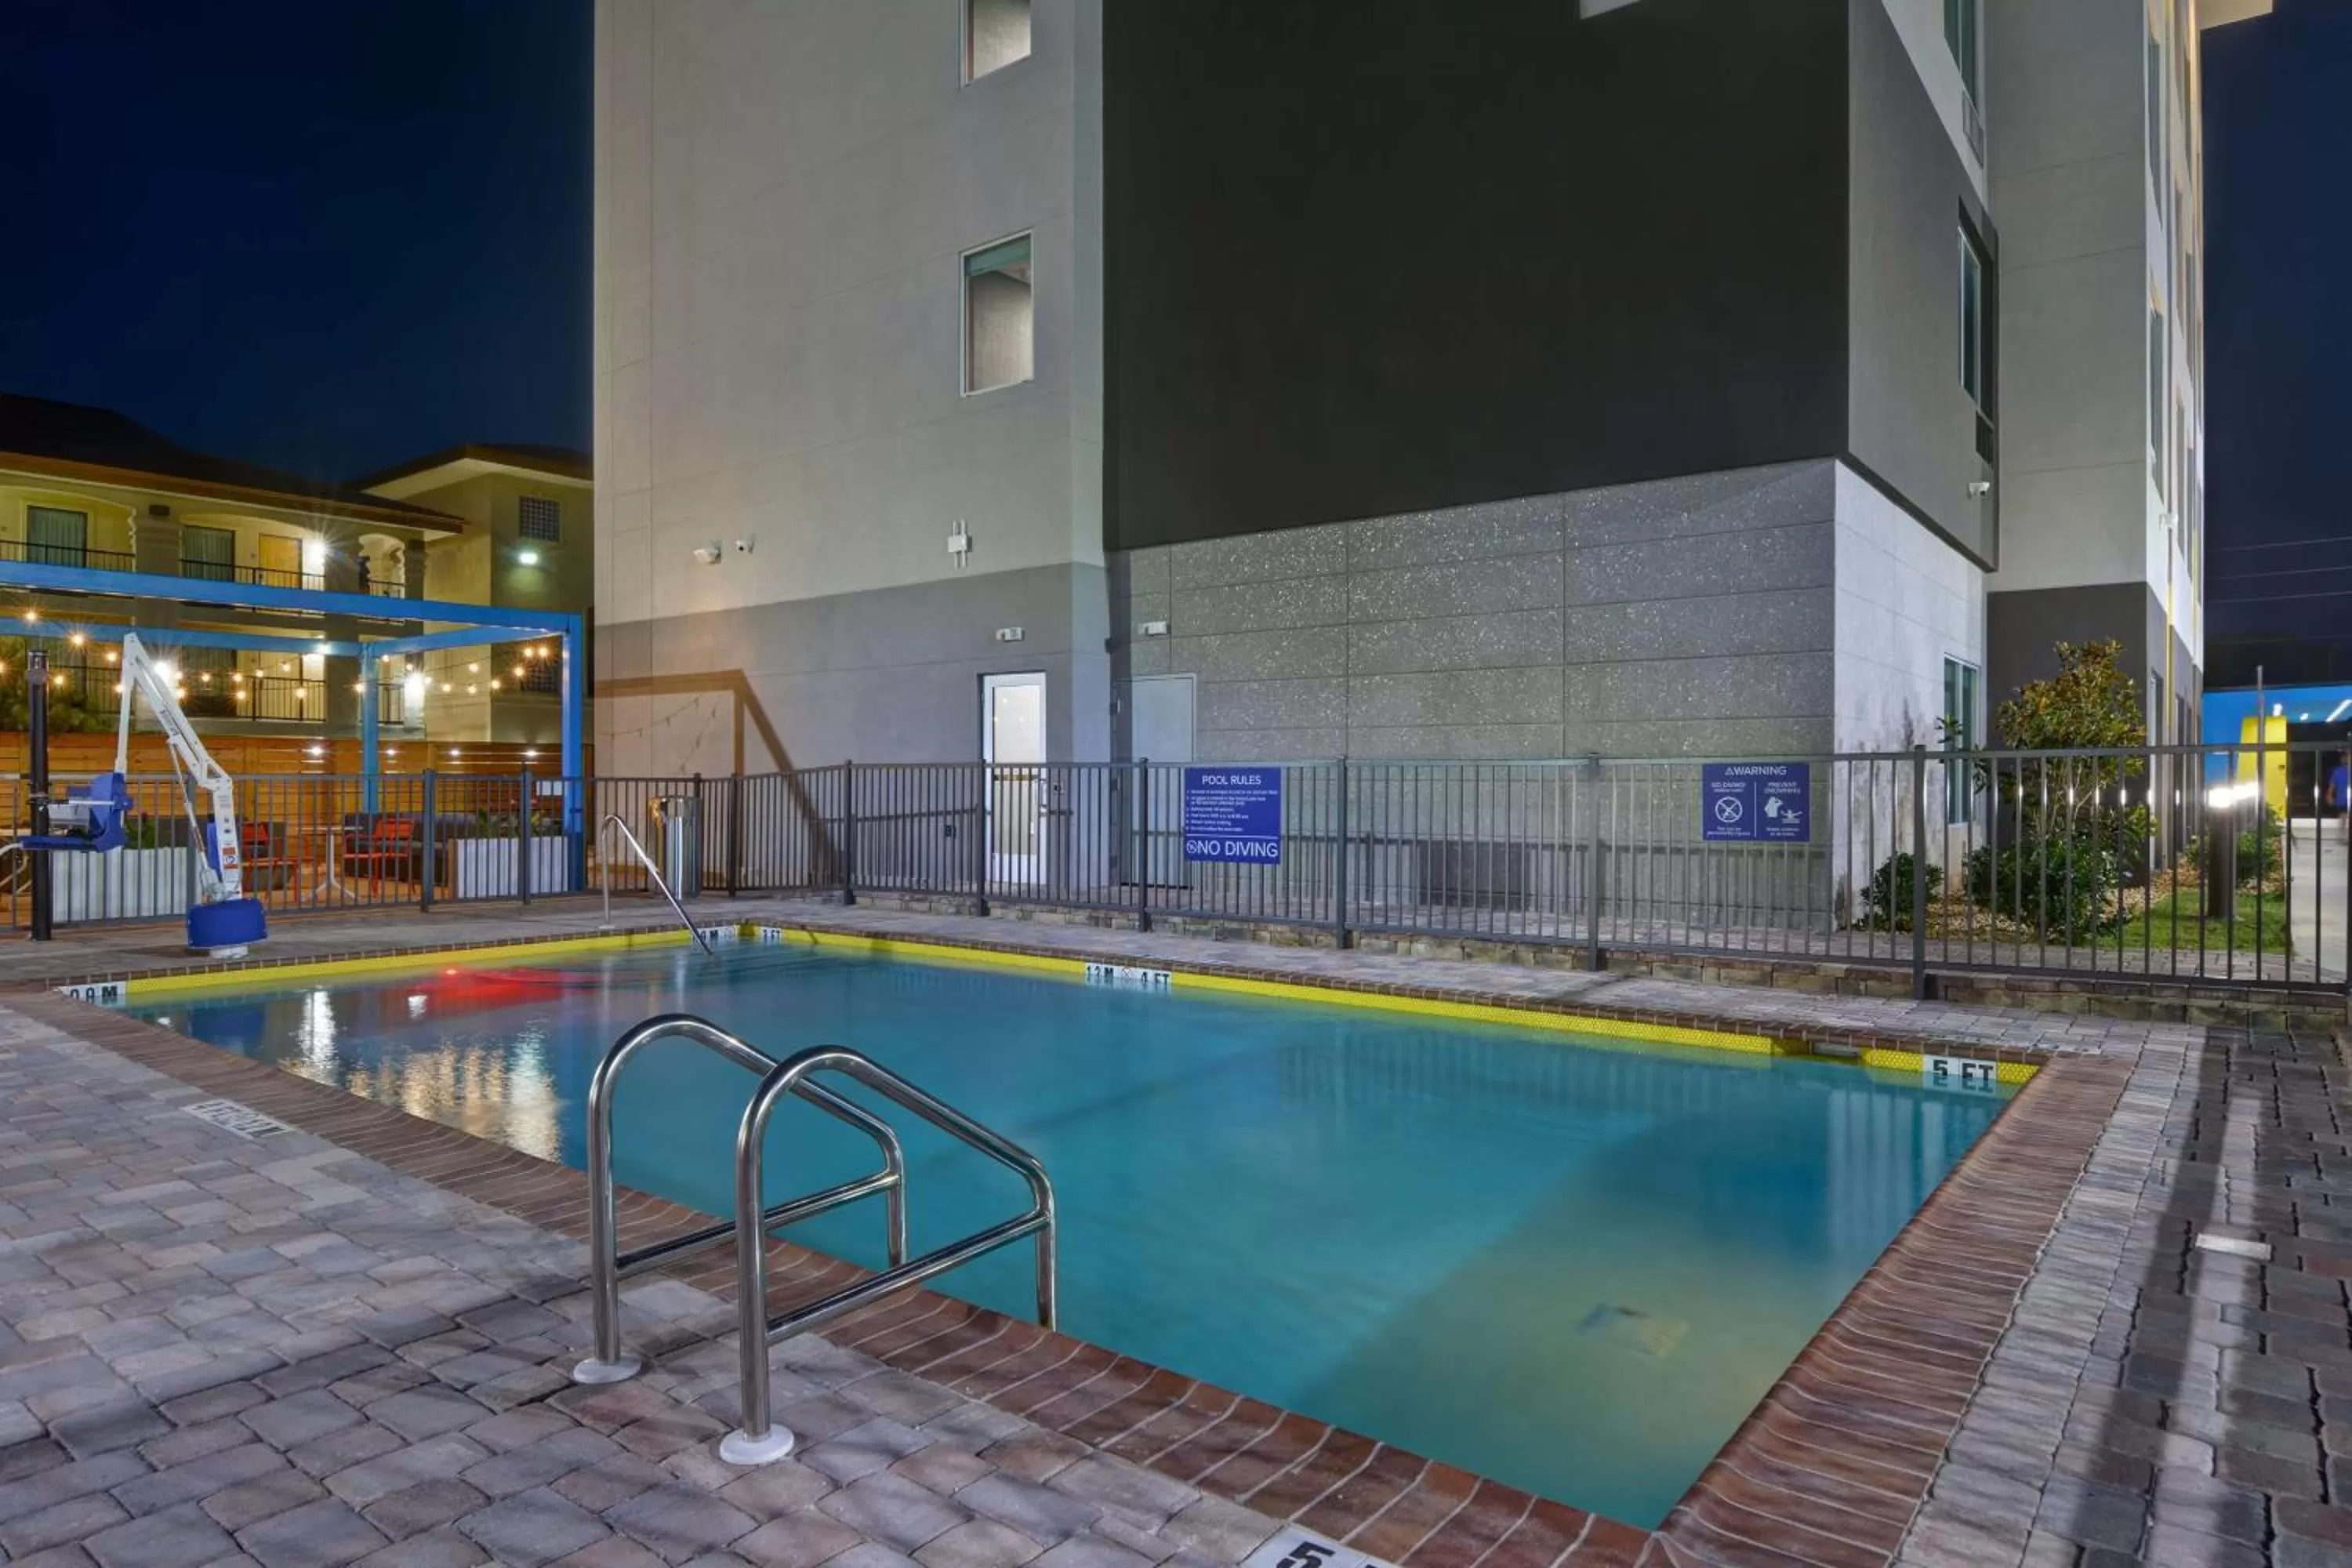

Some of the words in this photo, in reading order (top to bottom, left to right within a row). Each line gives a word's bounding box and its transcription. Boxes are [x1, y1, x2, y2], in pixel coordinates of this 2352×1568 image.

[1734, 766, 1787, 775] WARNING
[1202, 775, 1228, 785] POOL
[1230, 775, 1261, 785] RULES
[1197, 840, 1221, 855] NO
[1225, 840, 1279, 858] DIVING
[1933, 1059, 1948, 1076] 5
[1962, 1062, 1993, 1080] FT
[1276, 1541, 1335, 1568] 5
